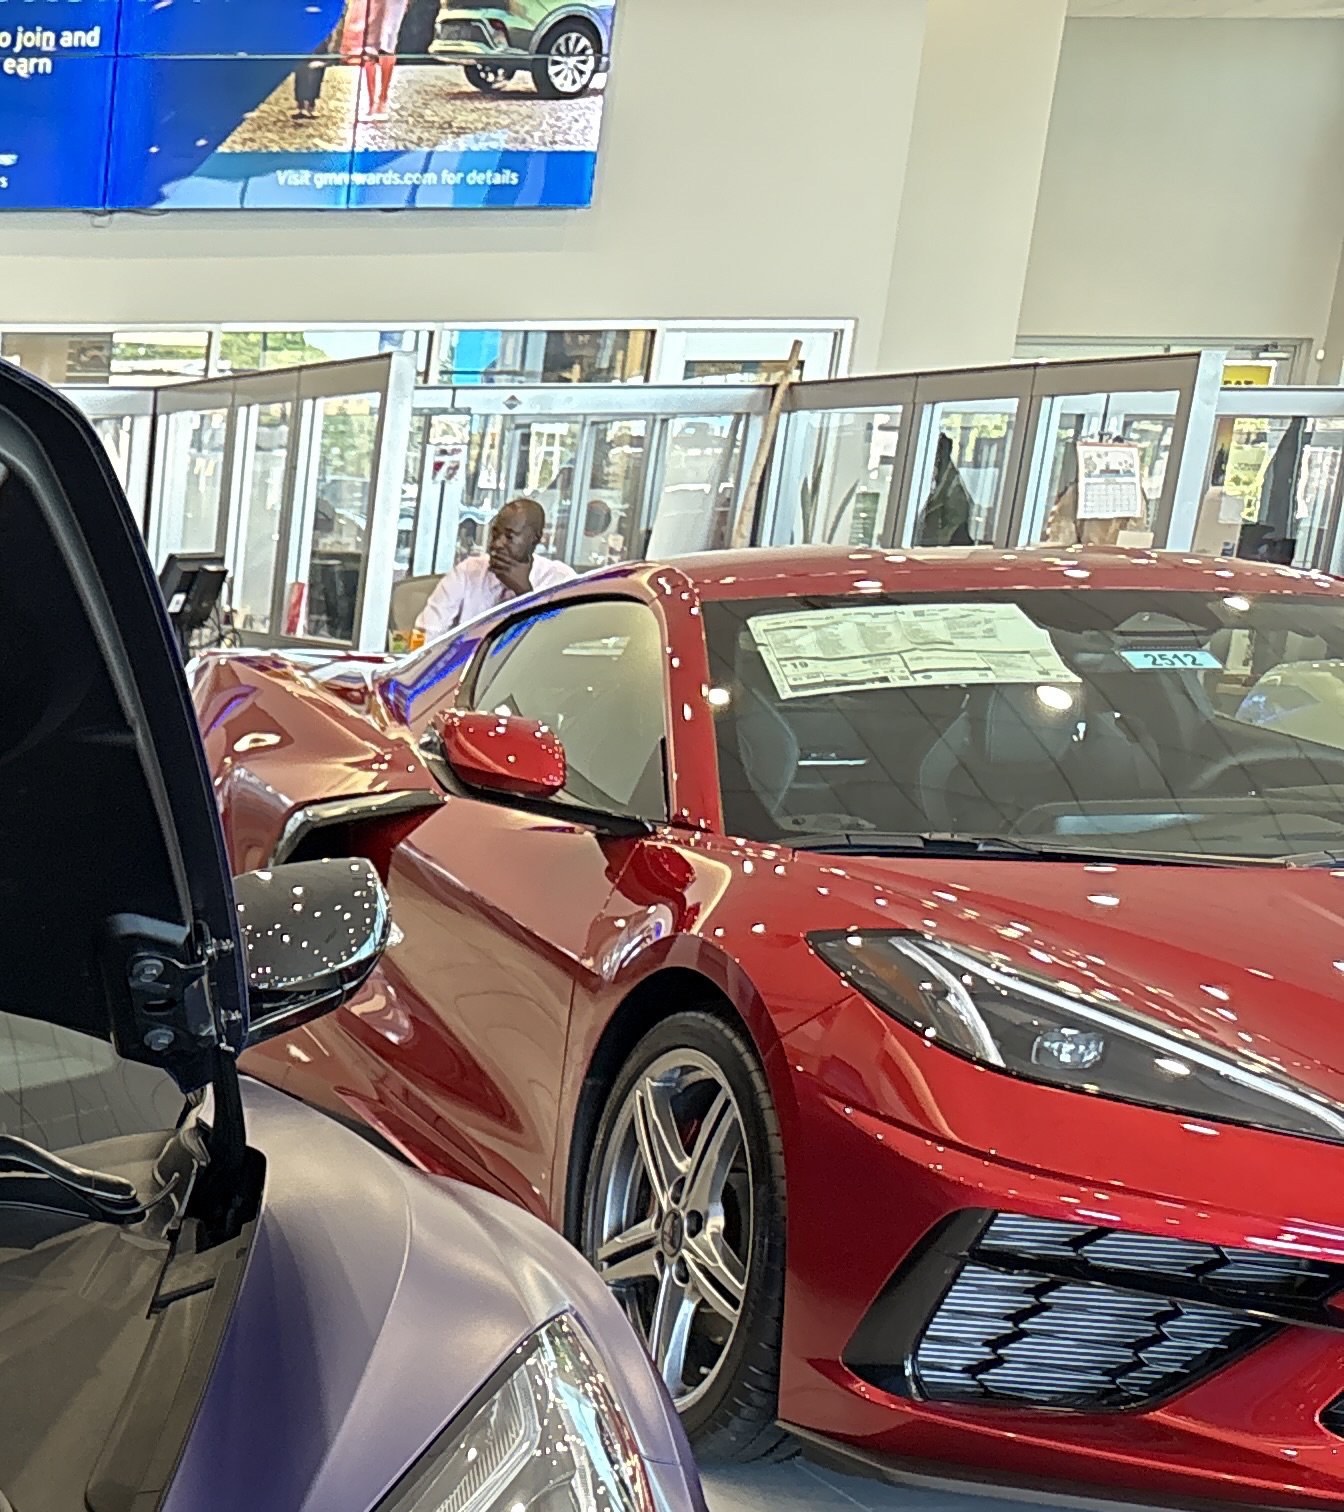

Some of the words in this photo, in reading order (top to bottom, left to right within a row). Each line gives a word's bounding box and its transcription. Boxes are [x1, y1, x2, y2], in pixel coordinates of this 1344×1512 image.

[12, 26, 56, 53] join
[59, 26, 101, 48] and
[2, 57, 53, 79] earn
[275, 169, 311, 185] Visit
[440, 169, 464, 185] for
[465, 168, 520, 185] details
[1143, 653, 1204, 666] 2512
